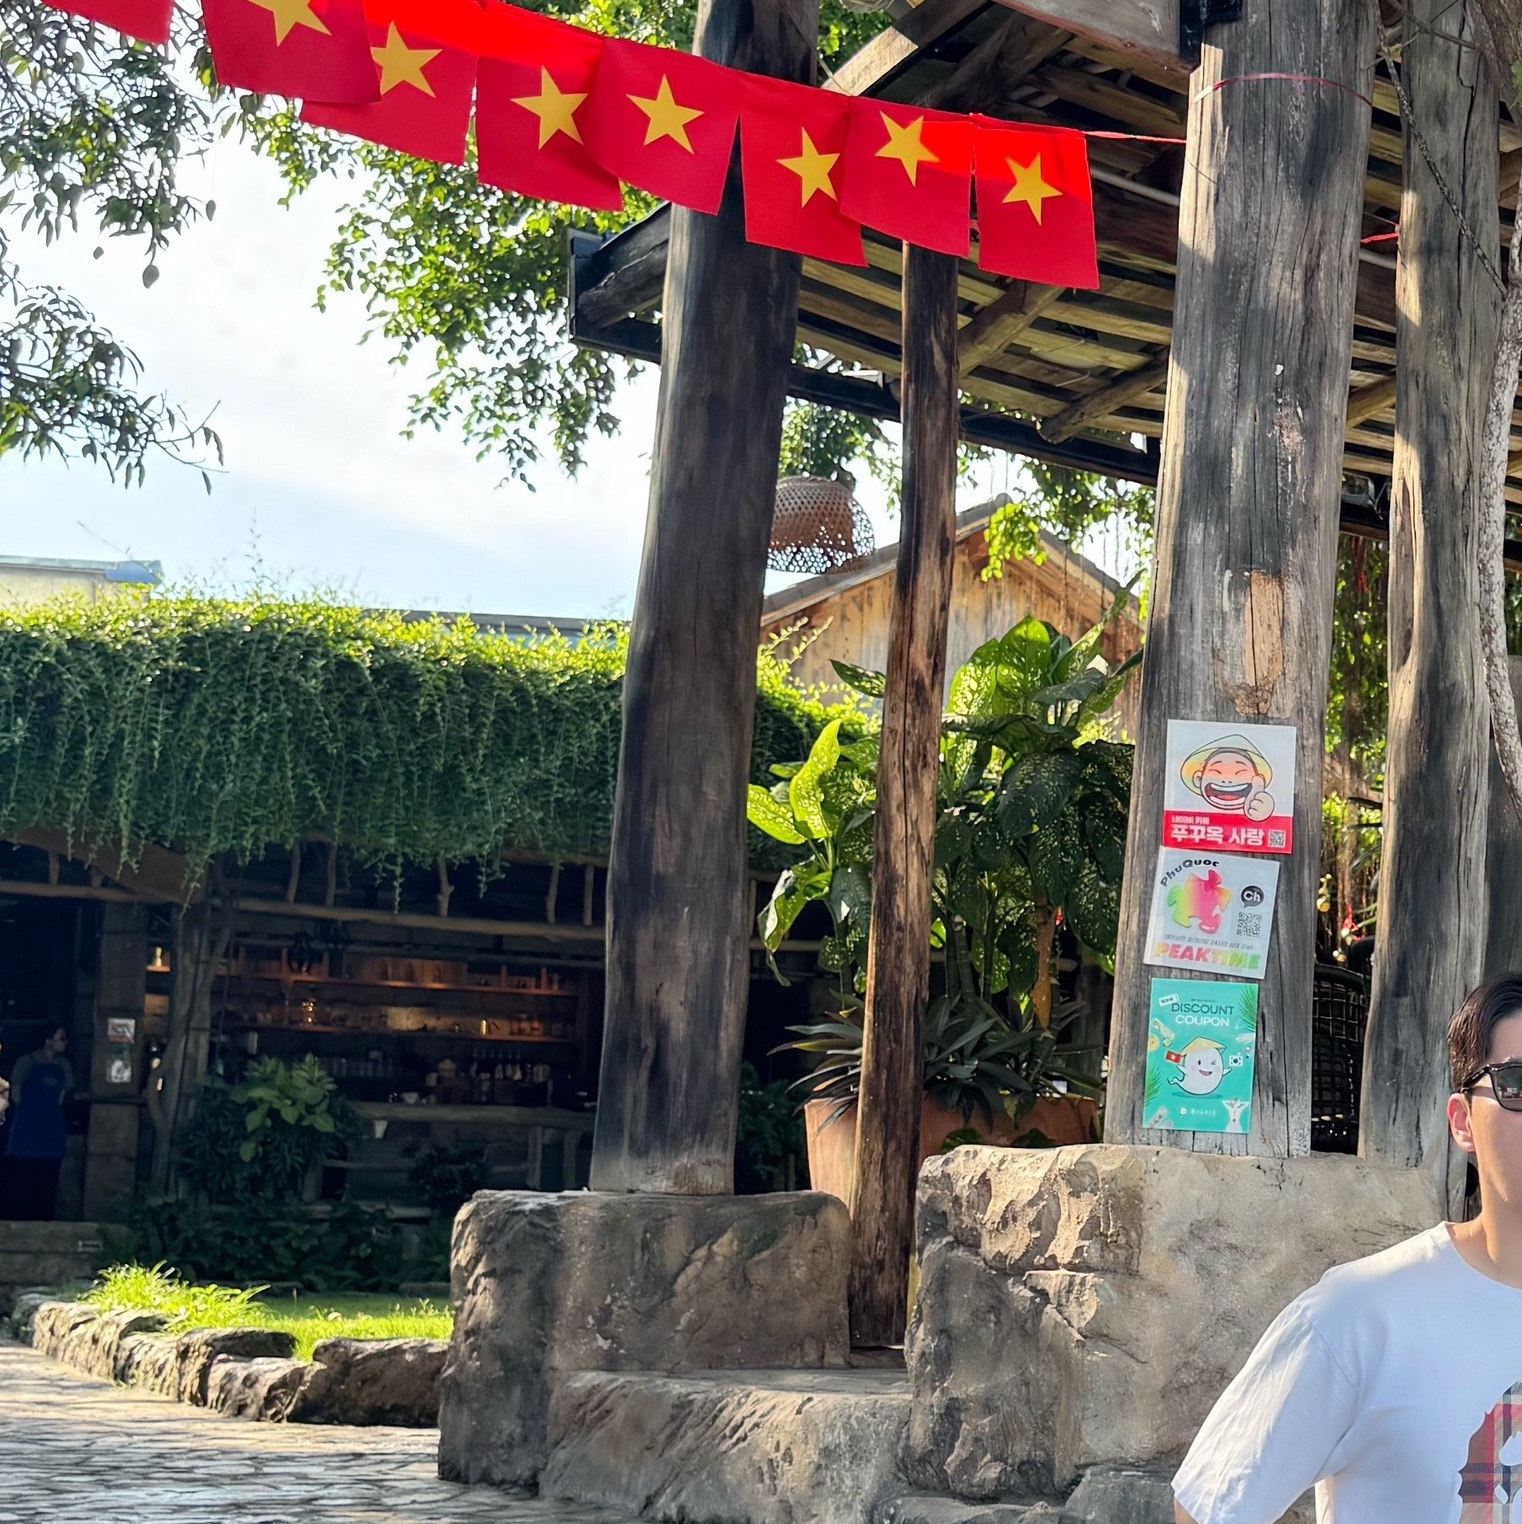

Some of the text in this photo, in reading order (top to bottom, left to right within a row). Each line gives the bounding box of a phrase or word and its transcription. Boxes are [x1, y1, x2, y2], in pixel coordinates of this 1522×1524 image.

[1171, 824, 1265, 846] 푸꾸옥 사랑
[1243, 890, 1261, 902] Ch
[1154, 942, 1261, 969] PEAKTIME
[1171, 1003, 1235, 1015] DISCOUNT
[1175, 1015, 1230, 1027] COUPON
